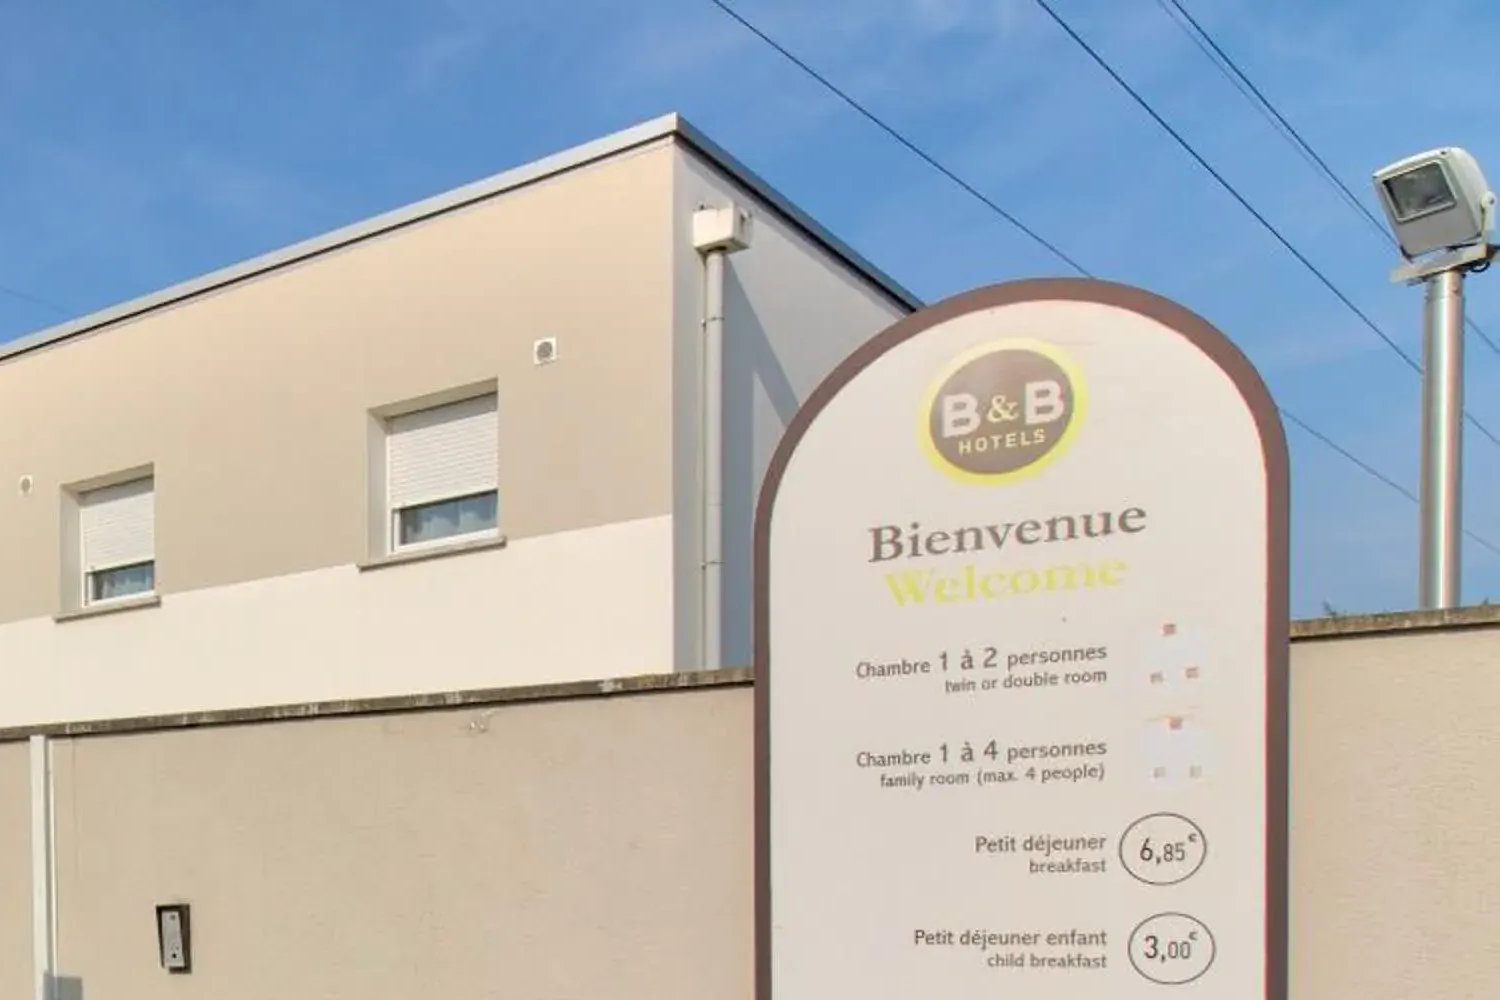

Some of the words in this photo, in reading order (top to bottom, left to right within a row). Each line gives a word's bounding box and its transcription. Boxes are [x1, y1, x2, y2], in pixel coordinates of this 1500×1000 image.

[941, 379, 1065, 438] B&B
[958, 428, 1046, 456] HOTELS
[867, 506, 1148, 563] Bienvenue
[885, 558, 1129, 609] Welcome
[856, 659, 931, 679] Chambre
[938, 651, 949, 672] 1
[960, 649, 974, 671] à
[982, 647, 998, 669] 2
[1006, 646, 1108, 669] personnes
[981, 678, 998, 691] or
[1003, 672, 1059, 689] double
[1064, 669, 1107, 684] room
[856, 751, 931, 768] Chambre
[939, 743, 949, 763] 1
[960, 741, 975, 762] à
[983, 739, 999, 761] 4
[1006, 741, 1108, 763] personnes
[880, 772, 924, 791] family
[929, 772, 970, 786] room
[1024, 766, 1036, 781] 4
[1041, 762, 1105, 784] people)
[975, 835, 1017, 852] Petit
[1023, 833, 1107, 857] déjeuner
[1028, 858, 1107, 874] breakfast
[914, 928, 954, 946] Petit
[959, 929, 1039, 951] déjeuner
[1046, 928, 1108, 946] enfant
[987, 953, 1025, 969] child
[1029, 953, 1108, 969] breakfast
